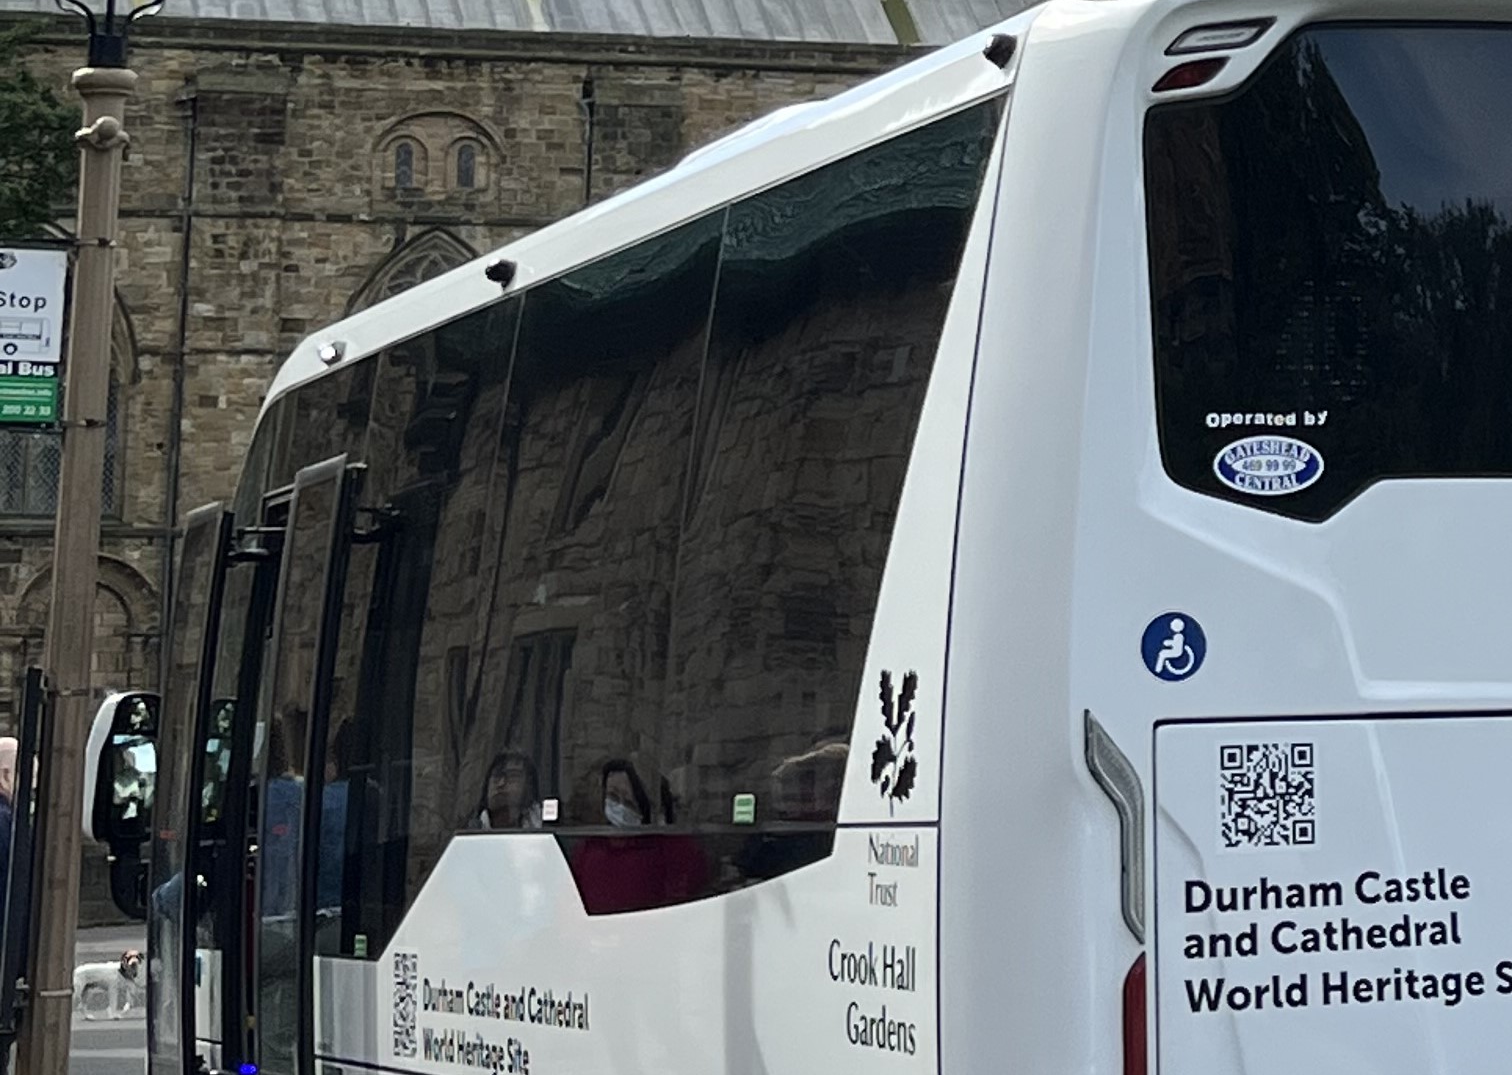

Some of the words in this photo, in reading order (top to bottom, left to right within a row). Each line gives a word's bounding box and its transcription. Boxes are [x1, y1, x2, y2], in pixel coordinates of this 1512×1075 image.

[18, 362, 55, 377] Bus
[1206, 412, 1297, 428] Operated
[1304, 410, 1328, 426] by
[1224, 440, 1310, 465] GATESHEAD
[1234, 473, 1300, 491] CENTRAL
[868, 833, 919, 868] National
[867, 872, 898, 907] Trust
[1185, 877, 1343, 913] Durham
[1355, 868, 1470, 904] Castle
[1183, 923, 1258, 959] and
[1271, 911, 1462, 954] Cathedral
[828, 938, 878, 987] Crook
[882, 944, 916, 992] Hall
[423, 978, 464, 1015] Durham
[467, 981, 501, 1020] Castle
[504, 986, 526, 1022] and
[528, 987, 590, 1031] Cathedral
[1185, 974, 1308, 1013] World
[1322, 968, 1485, 1006] Heritage
[422, 1027, 455, 1063] World
[457, 1029, 505, 1075] Heritage
[507, 1037, 530, 1075] Site
[846, 1001, 916, 1056] Gardens
